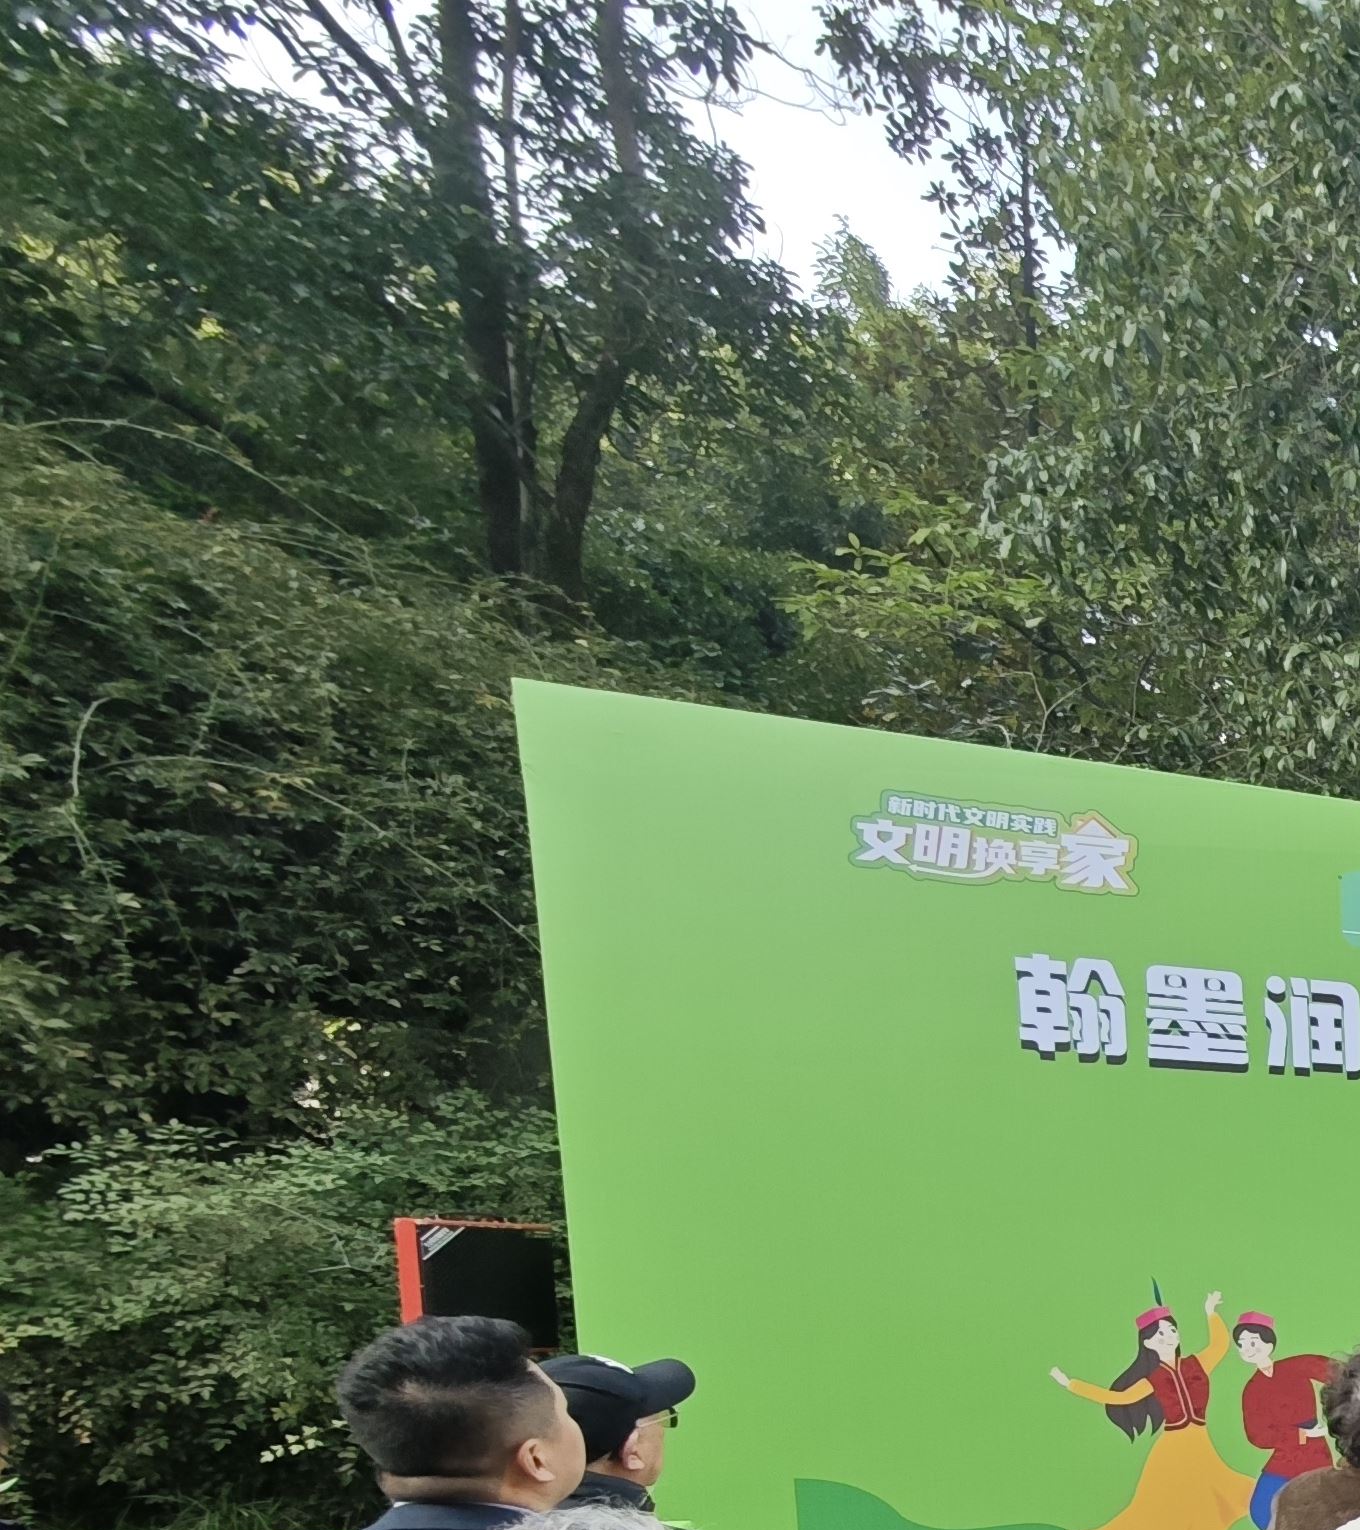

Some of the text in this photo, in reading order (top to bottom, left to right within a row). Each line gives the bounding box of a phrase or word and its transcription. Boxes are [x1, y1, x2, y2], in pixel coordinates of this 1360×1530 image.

[887, 795, 1057, 838] 新时代文明实践
[855, 818, 1131, 890] 文明换享家
